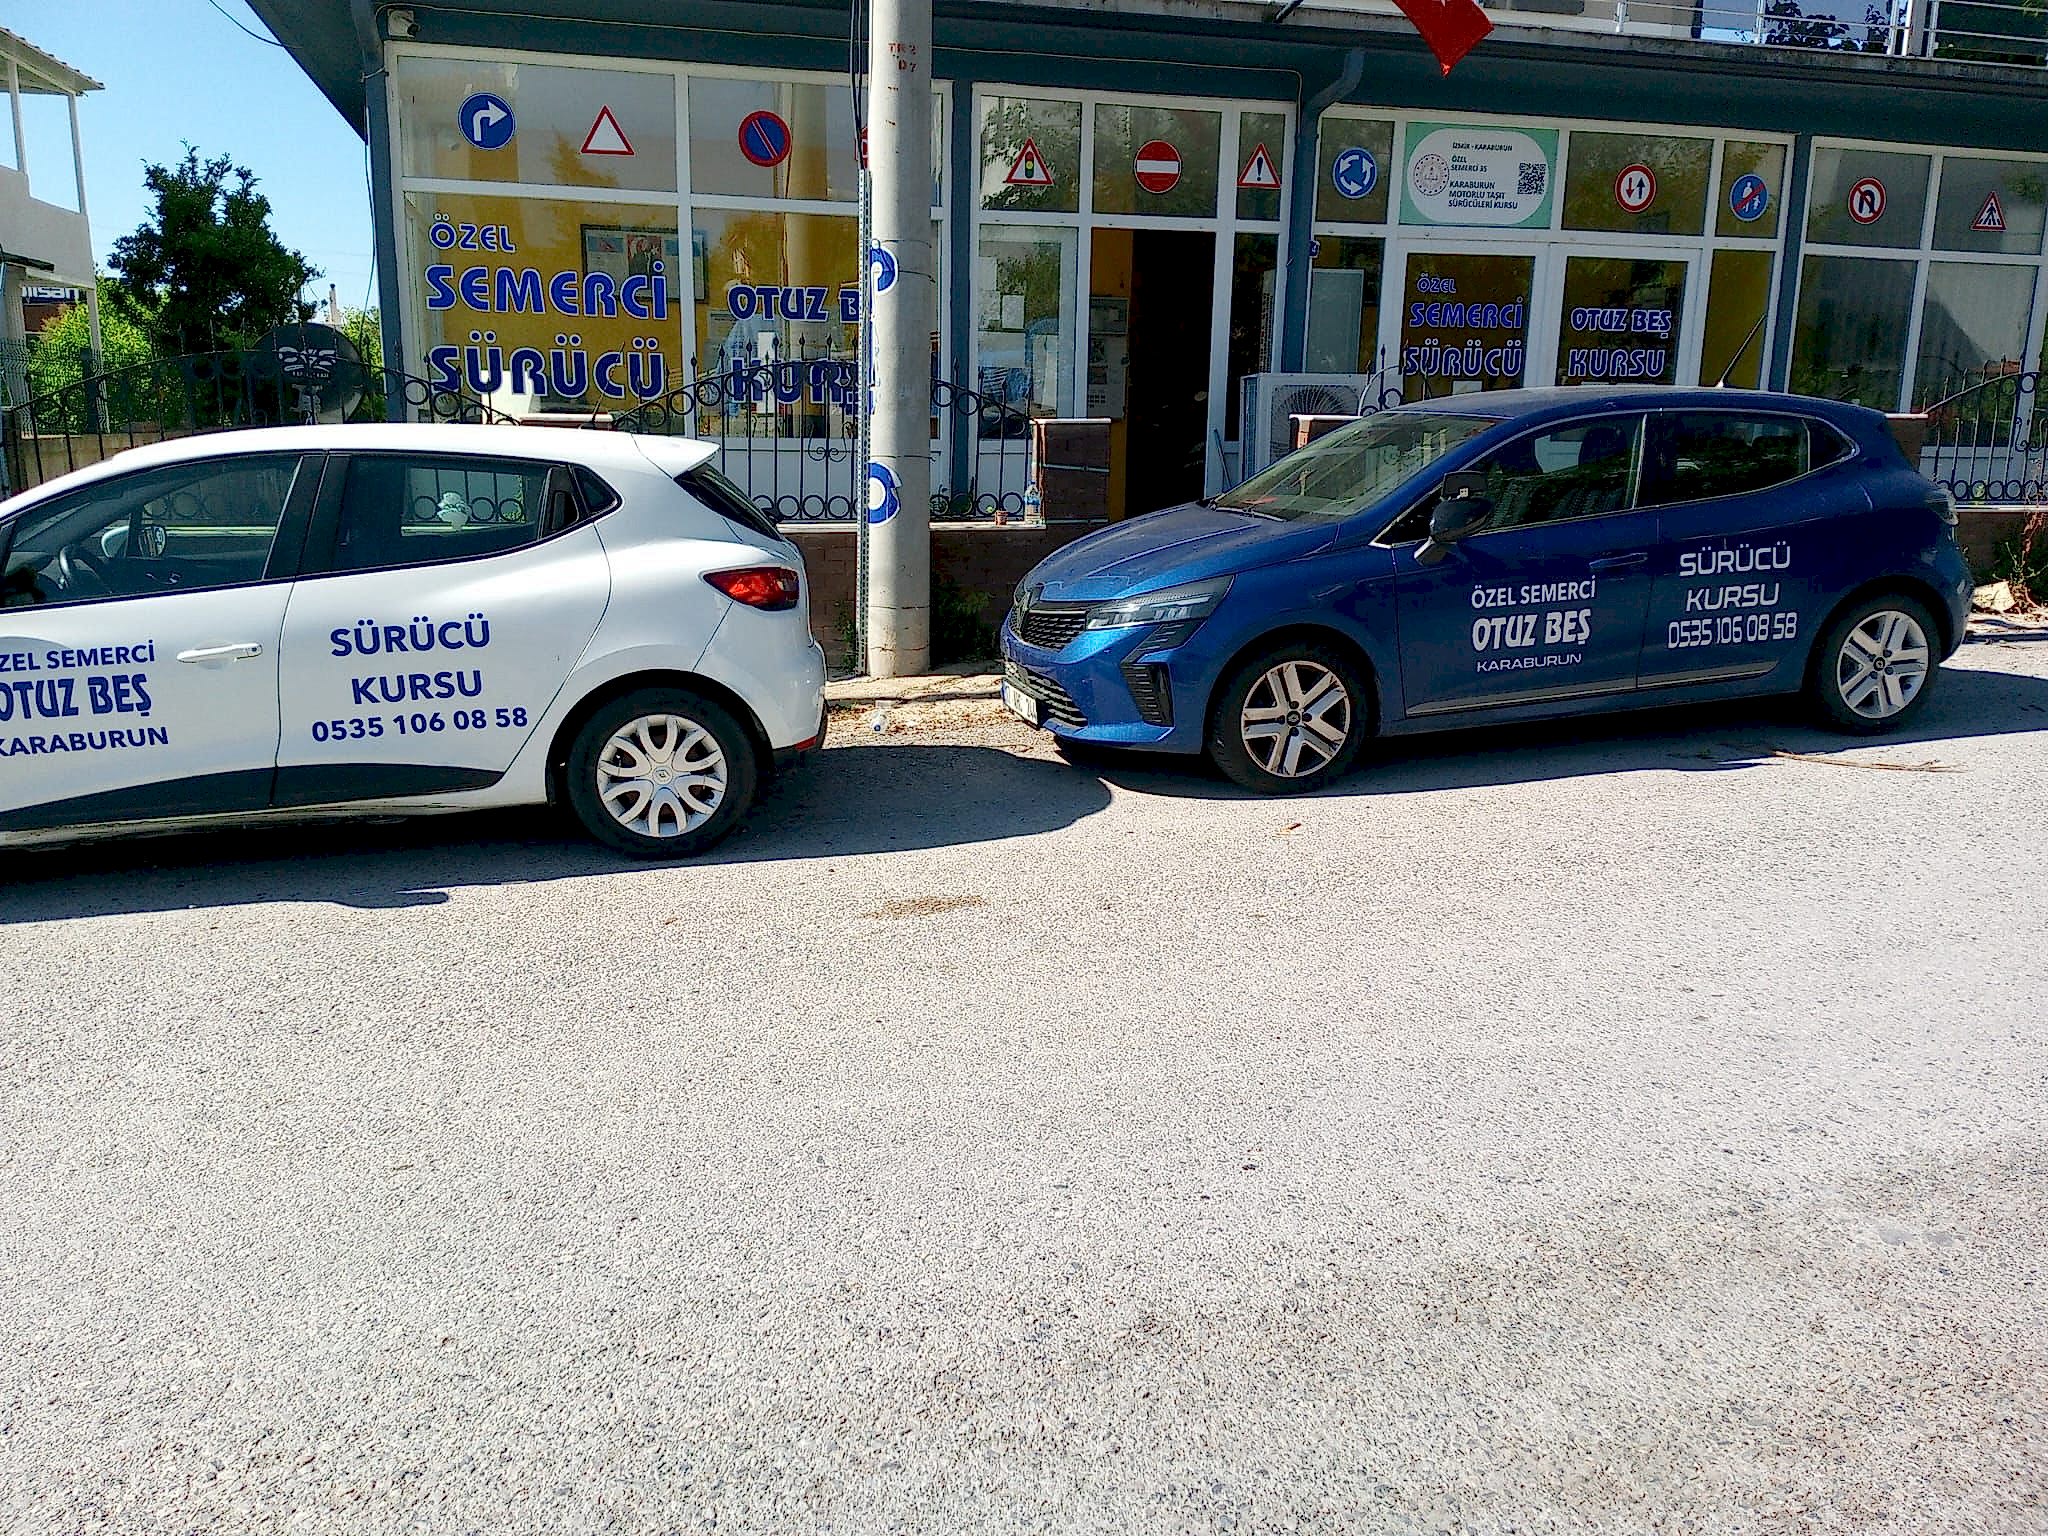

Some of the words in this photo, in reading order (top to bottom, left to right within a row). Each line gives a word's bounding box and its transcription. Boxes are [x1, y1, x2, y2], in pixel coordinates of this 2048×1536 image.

[1452, 154, 1467, 163] ÖZEL
[1475, 143, 1513, 152] KARABURUN
[1449, 190, 1485, 199] MOTORLU
[1450, 181, 1496, 190] KARABURUN
[1448, 198, 1493, 208] SÜRÜCÜLERİ
[1493, 201, 1518, 209] KURSU
[429, 212, 516, 253] ÖZEL
[426, 260, 668, 320] SEMERCİ
[1417, 272, 1457, 294] ÖZEL
[727, 285, 830, 322] OTUZ
[1409, 296, 1524, 329] SEMERCİ
[1570, 308, 1627, 332] OTUZ
[1631, 309, 1672, 339] BEŞ
[428, 328, 666, 400] SÜRÜCÜ
[1404, 337, 1523, 377] SÜRÜCÜ
[1568, 348, 1666, 377] KURSU
[731, 357, 861, 404] KUR
[1679, 540, 1792, 577] SÜRÜCÜ
[1471, 584, 1517, 609] ÖZEL
[1519, 575, 1597, 605] SEMERCİ
[1685, 583, 1781, 612] KURSU
[330, 612, 490, 657] SÜRÜCÜ
[1472, 613, 1539, 651] OTUZ
[1544, 608, 1592, 646] BEŞ
[1667, 619, 1713, 650] 0535
[1715, 616, 1743, 645] 106
[1746, 615, 1771, 642] 08
[1772, 611, 1798, 641] 58
[46, 639, 156, 669] SEMERCİ
[1476, 652, 1583, 673] KARABURUN
[0, 678, 79, 722] OTUZ
[87, 673, 152, 717] BEŞ
[351, 669, 483, 705] KURSU
[311, 716, 384, 742] 0535
[392, 712, 446, 735] 106
[453, 709, 488, 730] 08
[495, 707, 529, 728] 58
